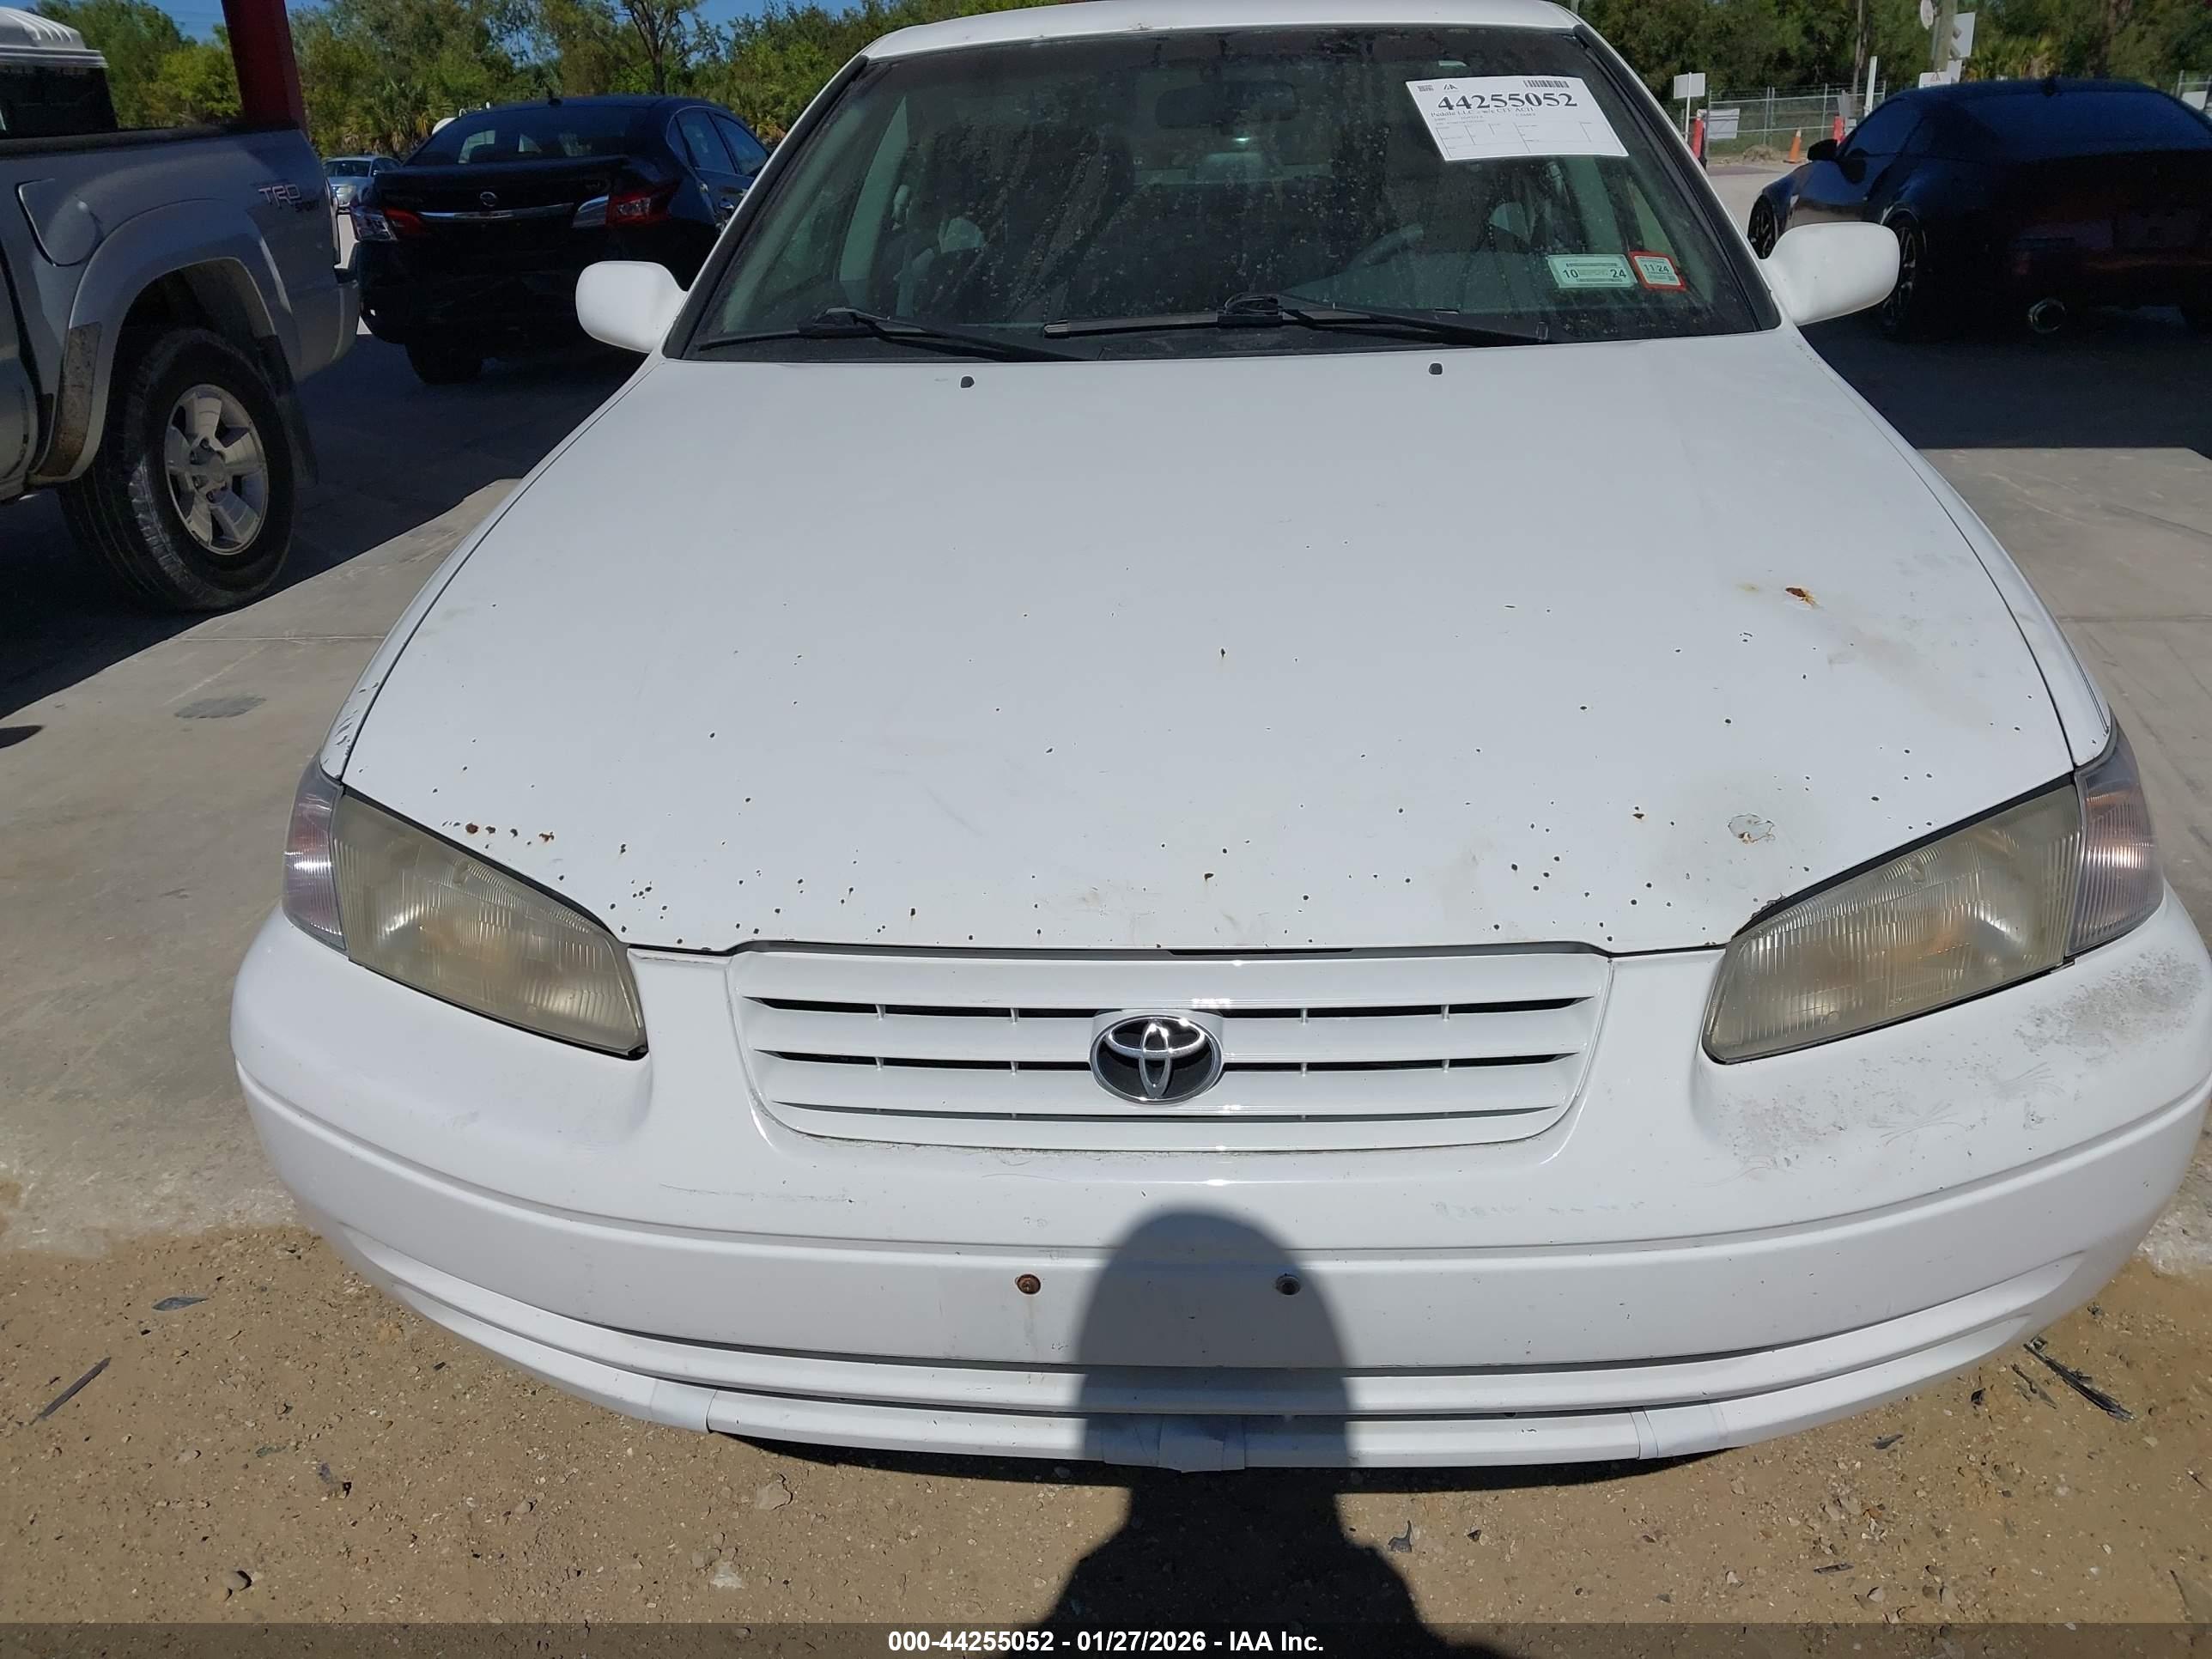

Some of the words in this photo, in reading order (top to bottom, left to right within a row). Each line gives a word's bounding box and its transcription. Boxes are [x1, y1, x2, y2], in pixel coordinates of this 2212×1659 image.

[1437, 92, 1578, 110] 44255052
[258, 184, 301, 207] TRD
[1563, 269, 1578, 278] 10
[1610, 269, 1627, 278] 24
[1644, 264, 1656, 272] 11
[1657, 265, 1669, 274] 24
